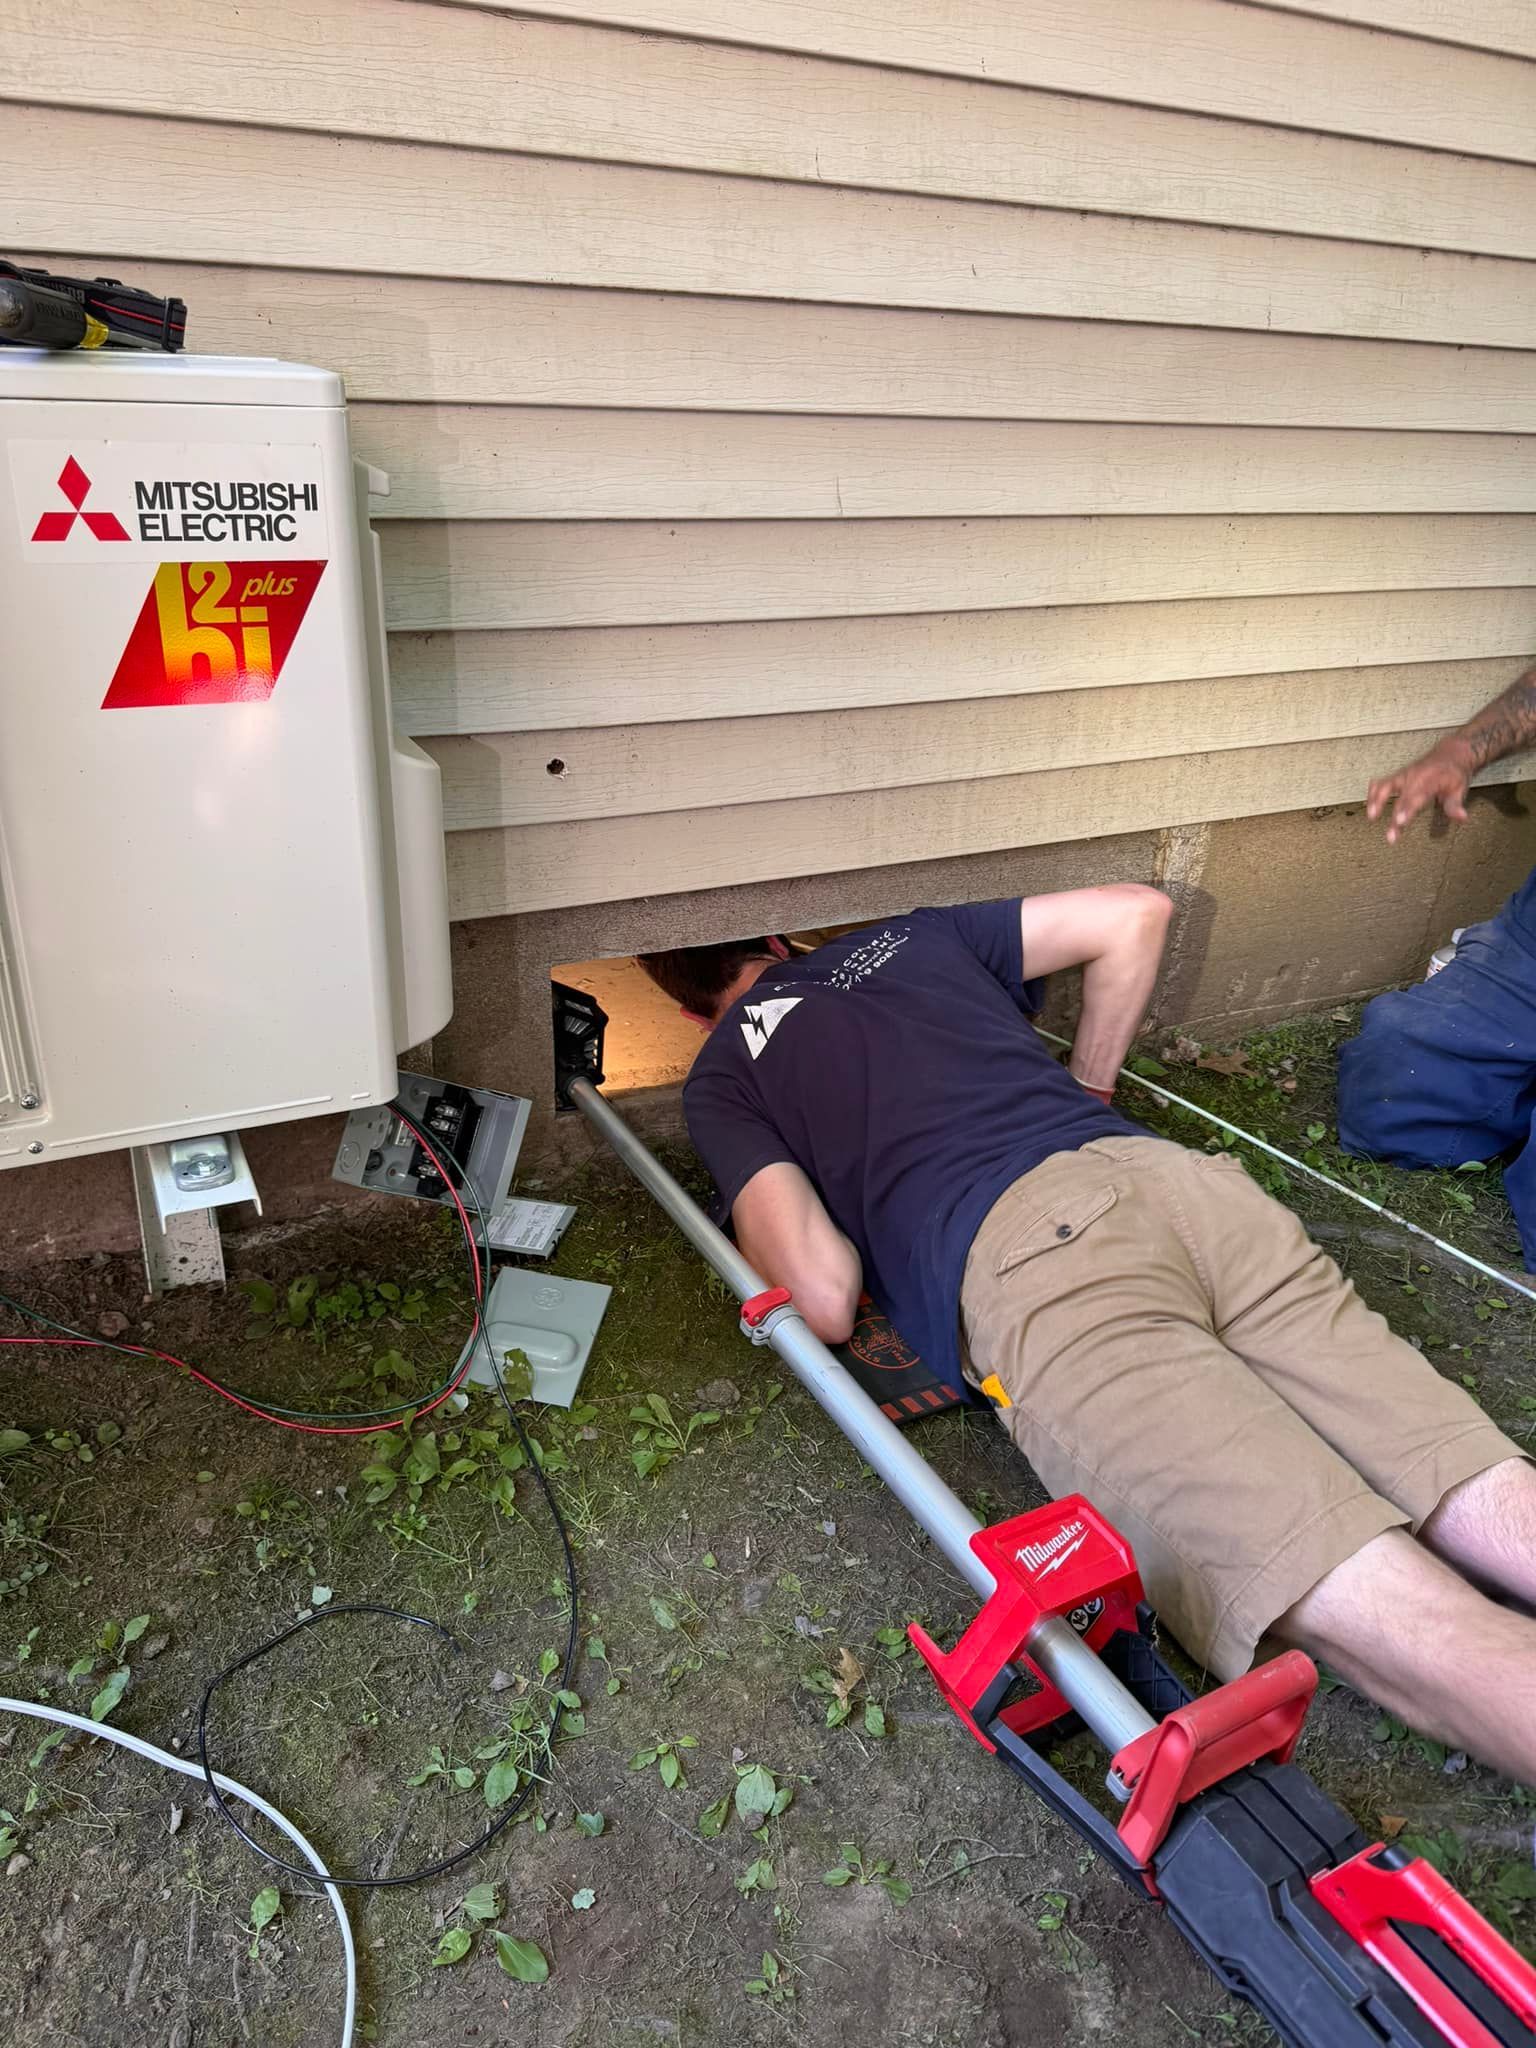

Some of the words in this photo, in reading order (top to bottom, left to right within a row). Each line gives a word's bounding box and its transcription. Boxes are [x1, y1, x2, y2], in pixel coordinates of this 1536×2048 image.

[135, 481, 319, 511] MITSUBISHI
[138, 513, 297, 542] ELECTRIC
[240, 571, 298, 602] plus
[853, 1335, 881, 1364] TOOLS
[1014, 1520, 1085, 1573] Milwaukee
